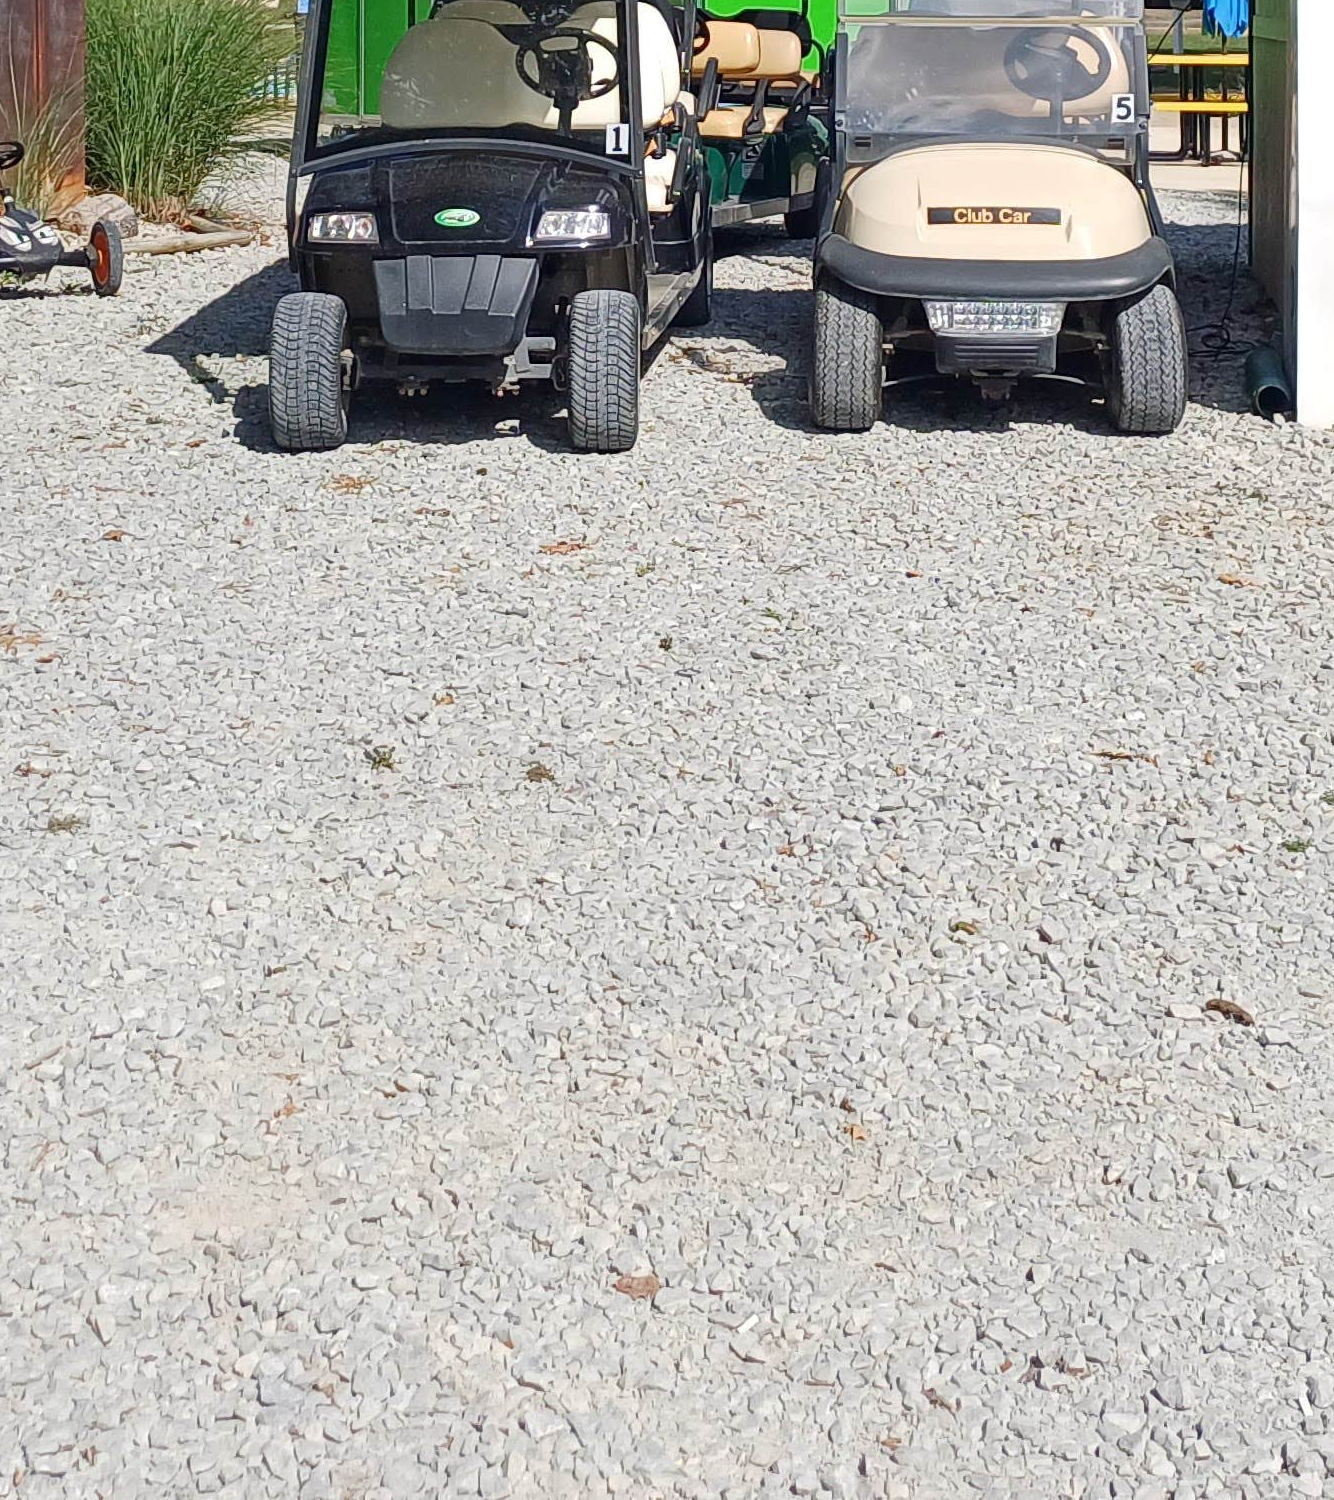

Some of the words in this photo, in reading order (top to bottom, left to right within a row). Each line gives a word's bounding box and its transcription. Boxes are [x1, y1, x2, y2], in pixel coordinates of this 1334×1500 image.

[1116, 96, 1132, 120] 5
[612, 126, 623, 152] 1
[953, 208, 994, 223] Club
[998, 208, 1031, 223] Car
